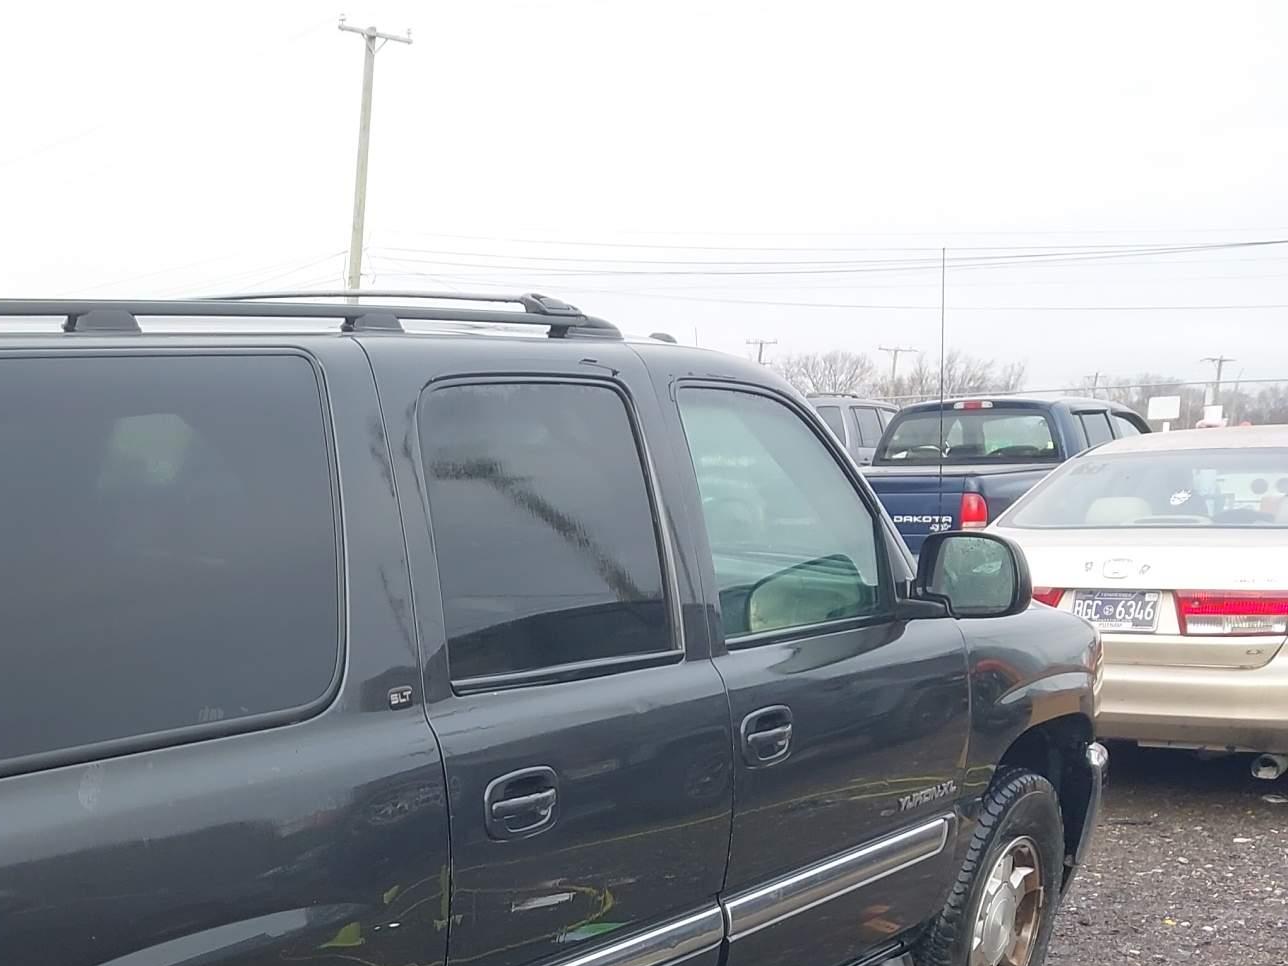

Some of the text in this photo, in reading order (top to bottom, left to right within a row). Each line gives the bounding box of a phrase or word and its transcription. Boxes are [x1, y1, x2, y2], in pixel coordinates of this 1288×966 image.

[893, 515, 953, 523] DAKOTA
[1115, 600, 1154, 621] 6346
[390, 690, 412, 705] SLT
